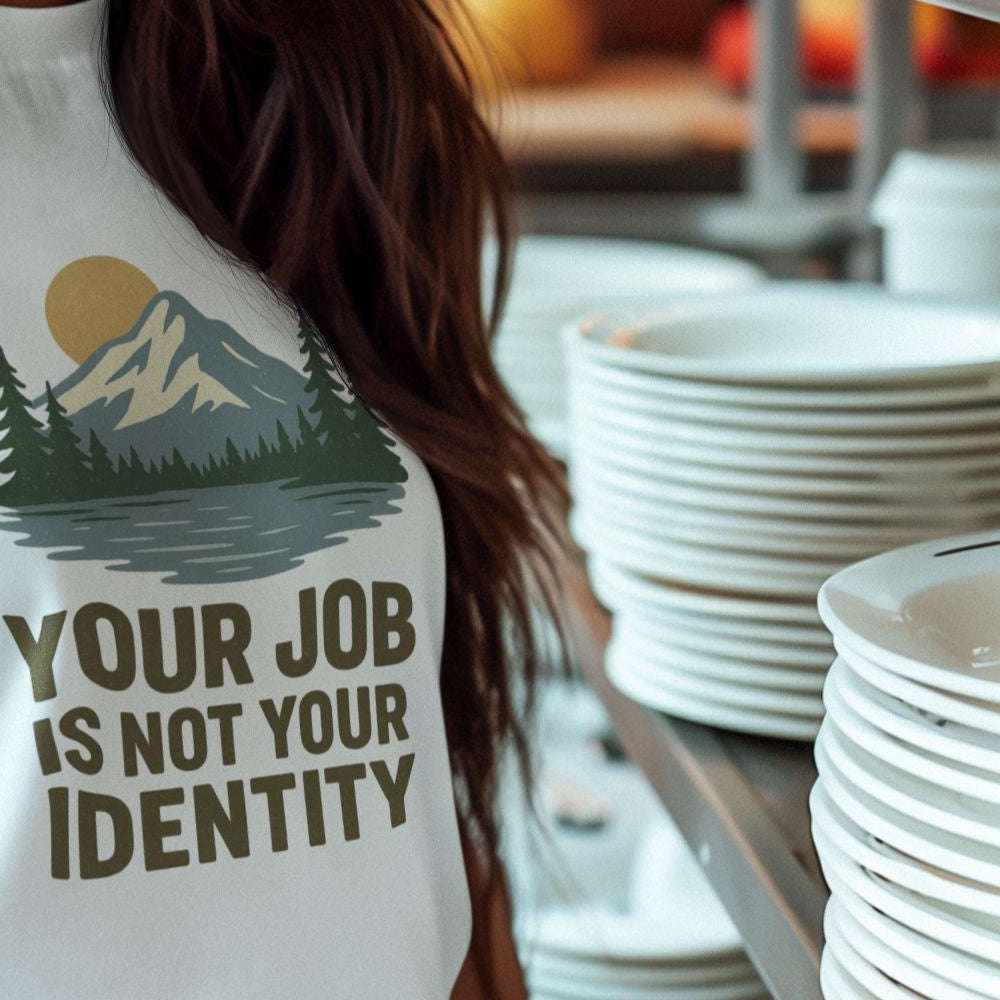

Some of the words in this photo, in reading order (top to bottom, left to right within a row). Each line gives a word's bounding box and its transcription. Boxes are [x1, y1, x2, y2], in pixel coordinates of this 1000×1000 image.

[2, 601, 255, 702] YOUR
[275, 578, 416, 679] JOB
[33, 706, 104, 776] IS
[120, 702, 243, 778] NOT
[258, 683, 411, 760] YOUR
[47, 753, 416, 881] IDENTITY
